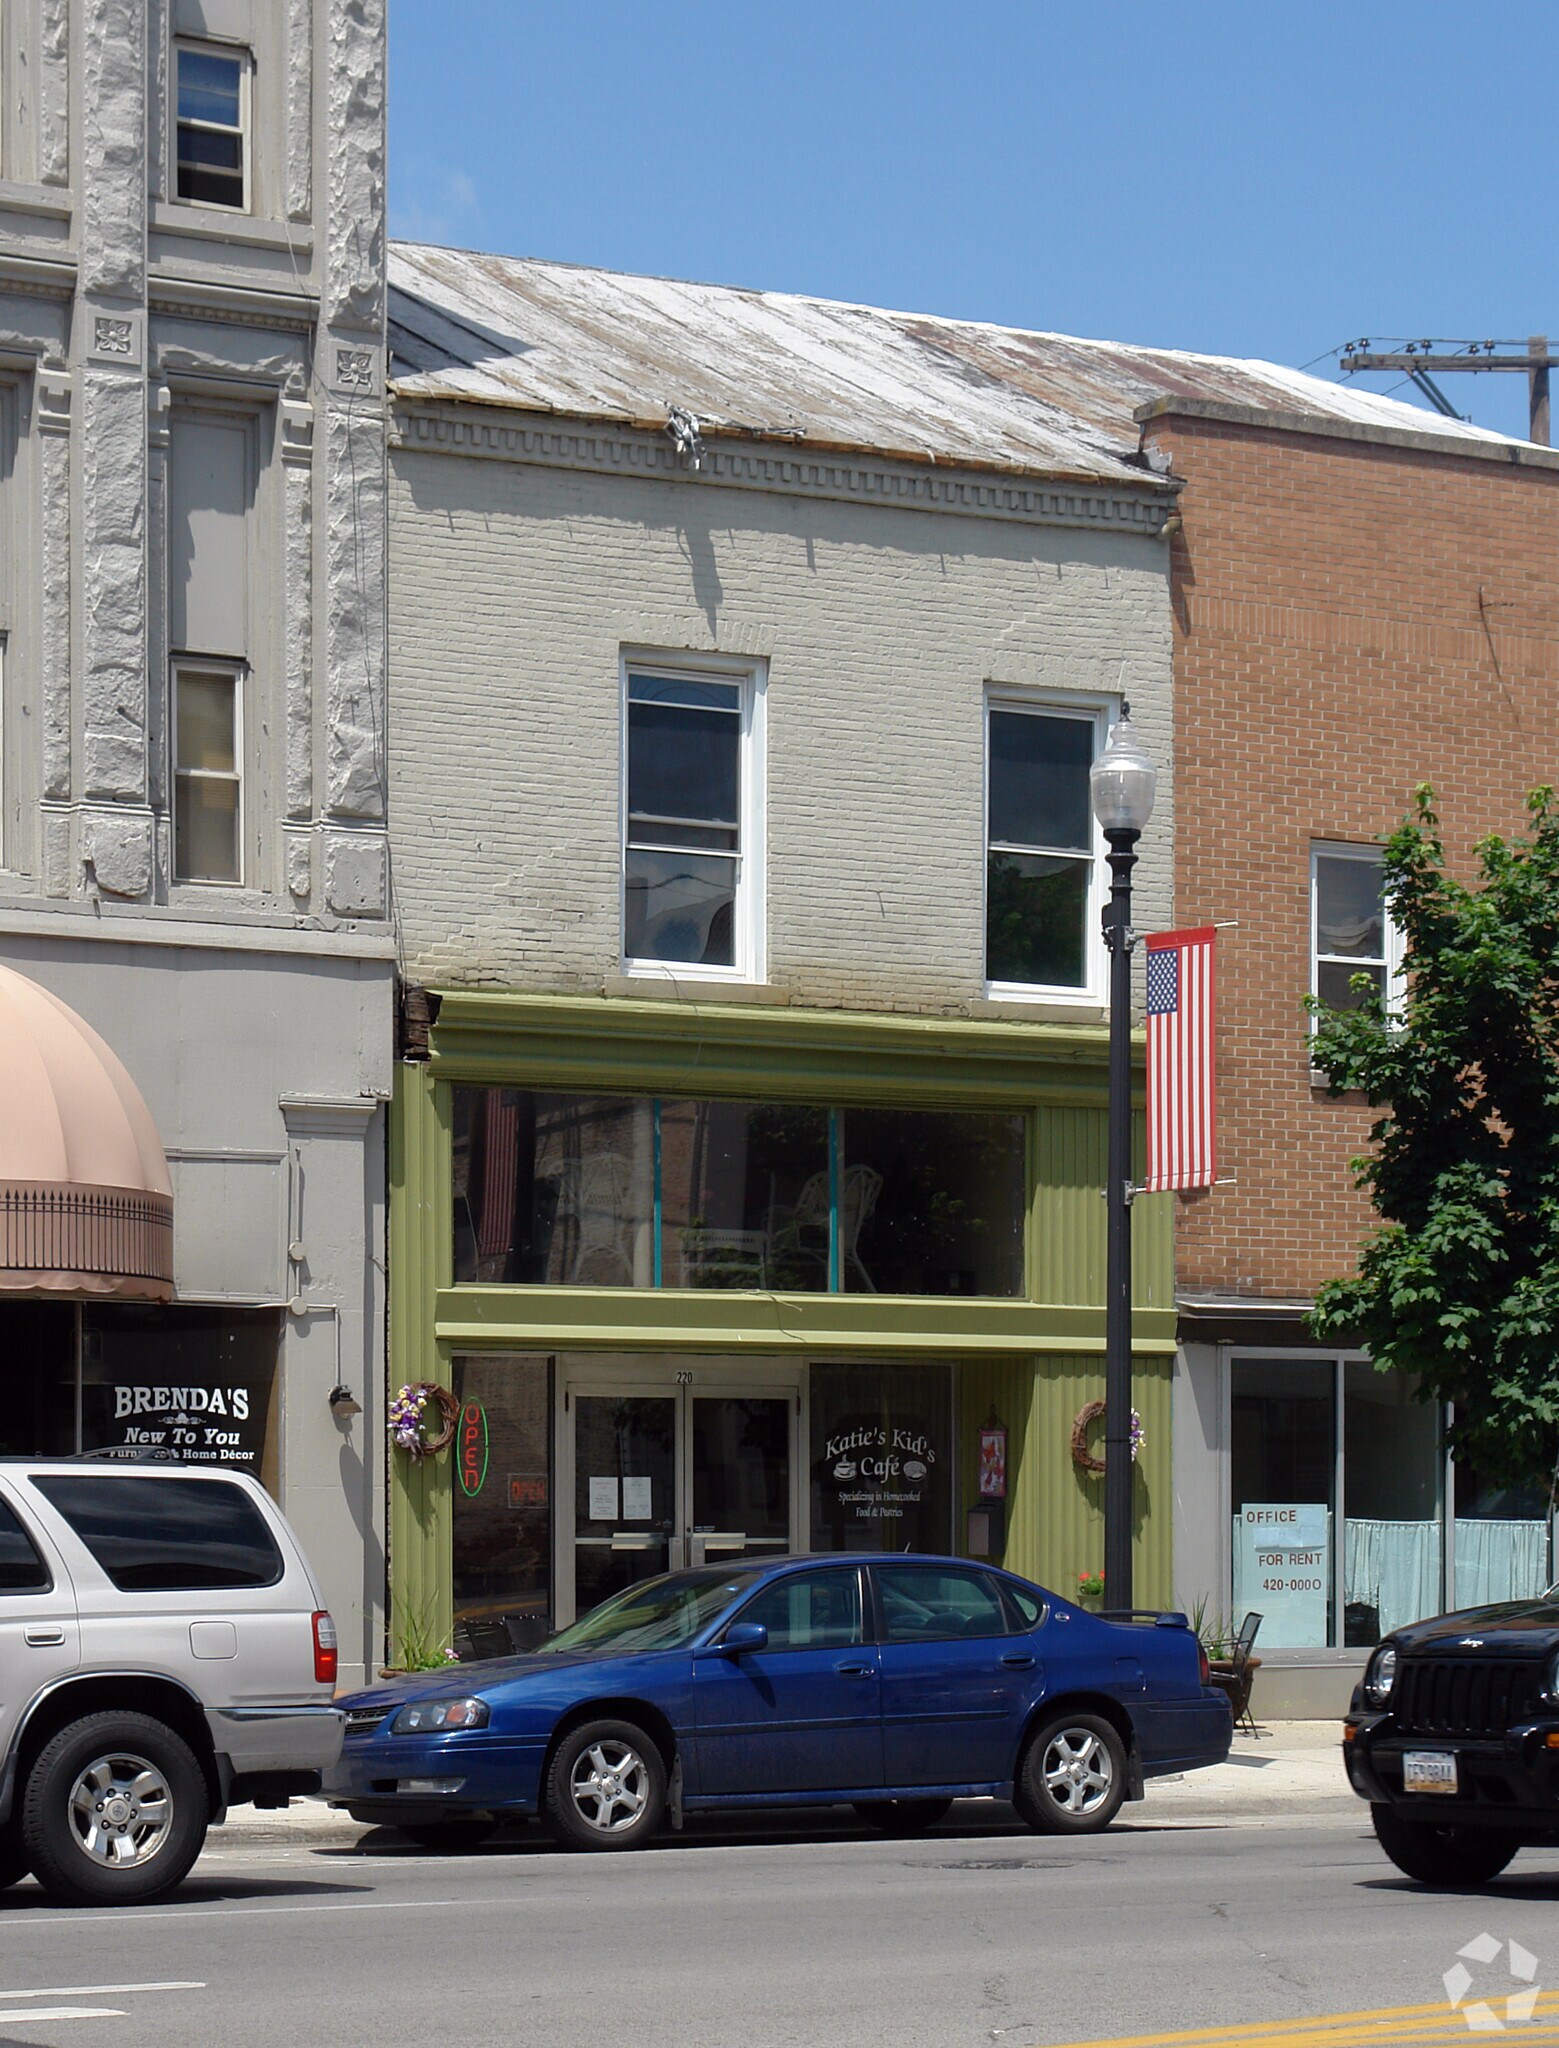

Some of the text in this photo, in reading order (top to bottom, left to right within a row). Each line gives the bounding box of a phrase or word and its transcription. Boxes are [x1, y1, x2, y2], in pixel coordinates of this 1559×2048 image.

[676, 1371, 693, 1384] 220
[114, 1386, 250, 1421] BRENDA'S
[123, 1427, 241, 1445] New To You
[465, 1404, 480, 1488] OPEN
[825, 1426, 936, 1463] Katie's Kid's
[182, 1449, 217, 1460] Home
[220, 1448, 255, 1460] Décor
[860, 1454, 900, 1484] Café
[1246, 1510, 1297, 1523] OFFICE
[1258, 1553, 1323, 1567] FOR RENT
[1262, 1578, 1322, 1591] 420-0000
